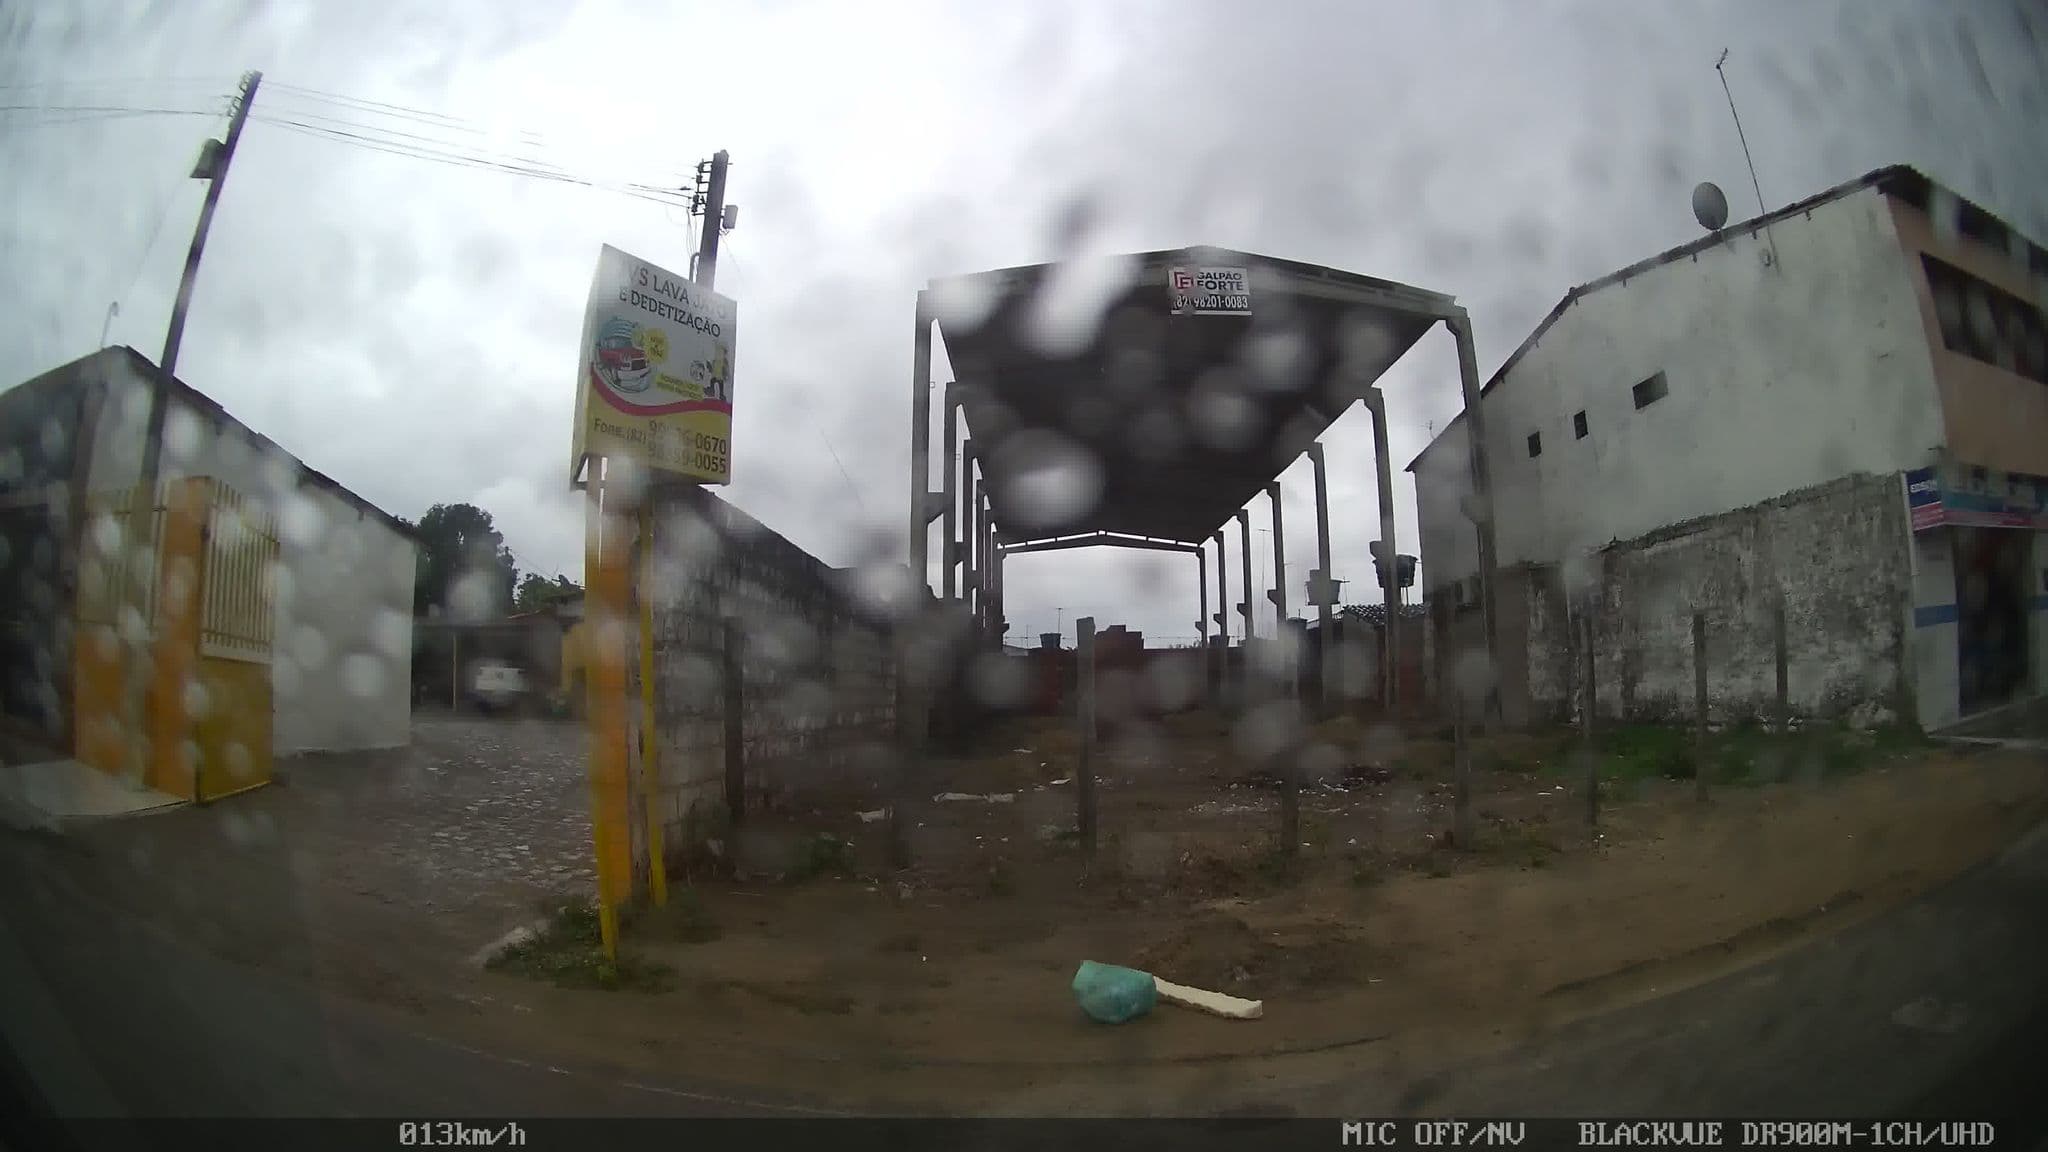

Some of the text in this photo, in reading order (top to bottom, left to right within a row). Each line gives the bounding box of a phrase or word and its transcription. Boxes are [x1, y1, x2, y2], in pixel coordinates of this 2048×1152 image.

[653, 275, 689, 305] LAVA
[1197, 280, 1244, 291] FORTE
[1194, 295, 1248, 309] 98201-0083
[631, 289, 721, 338] DEDETIZAÇÃO
